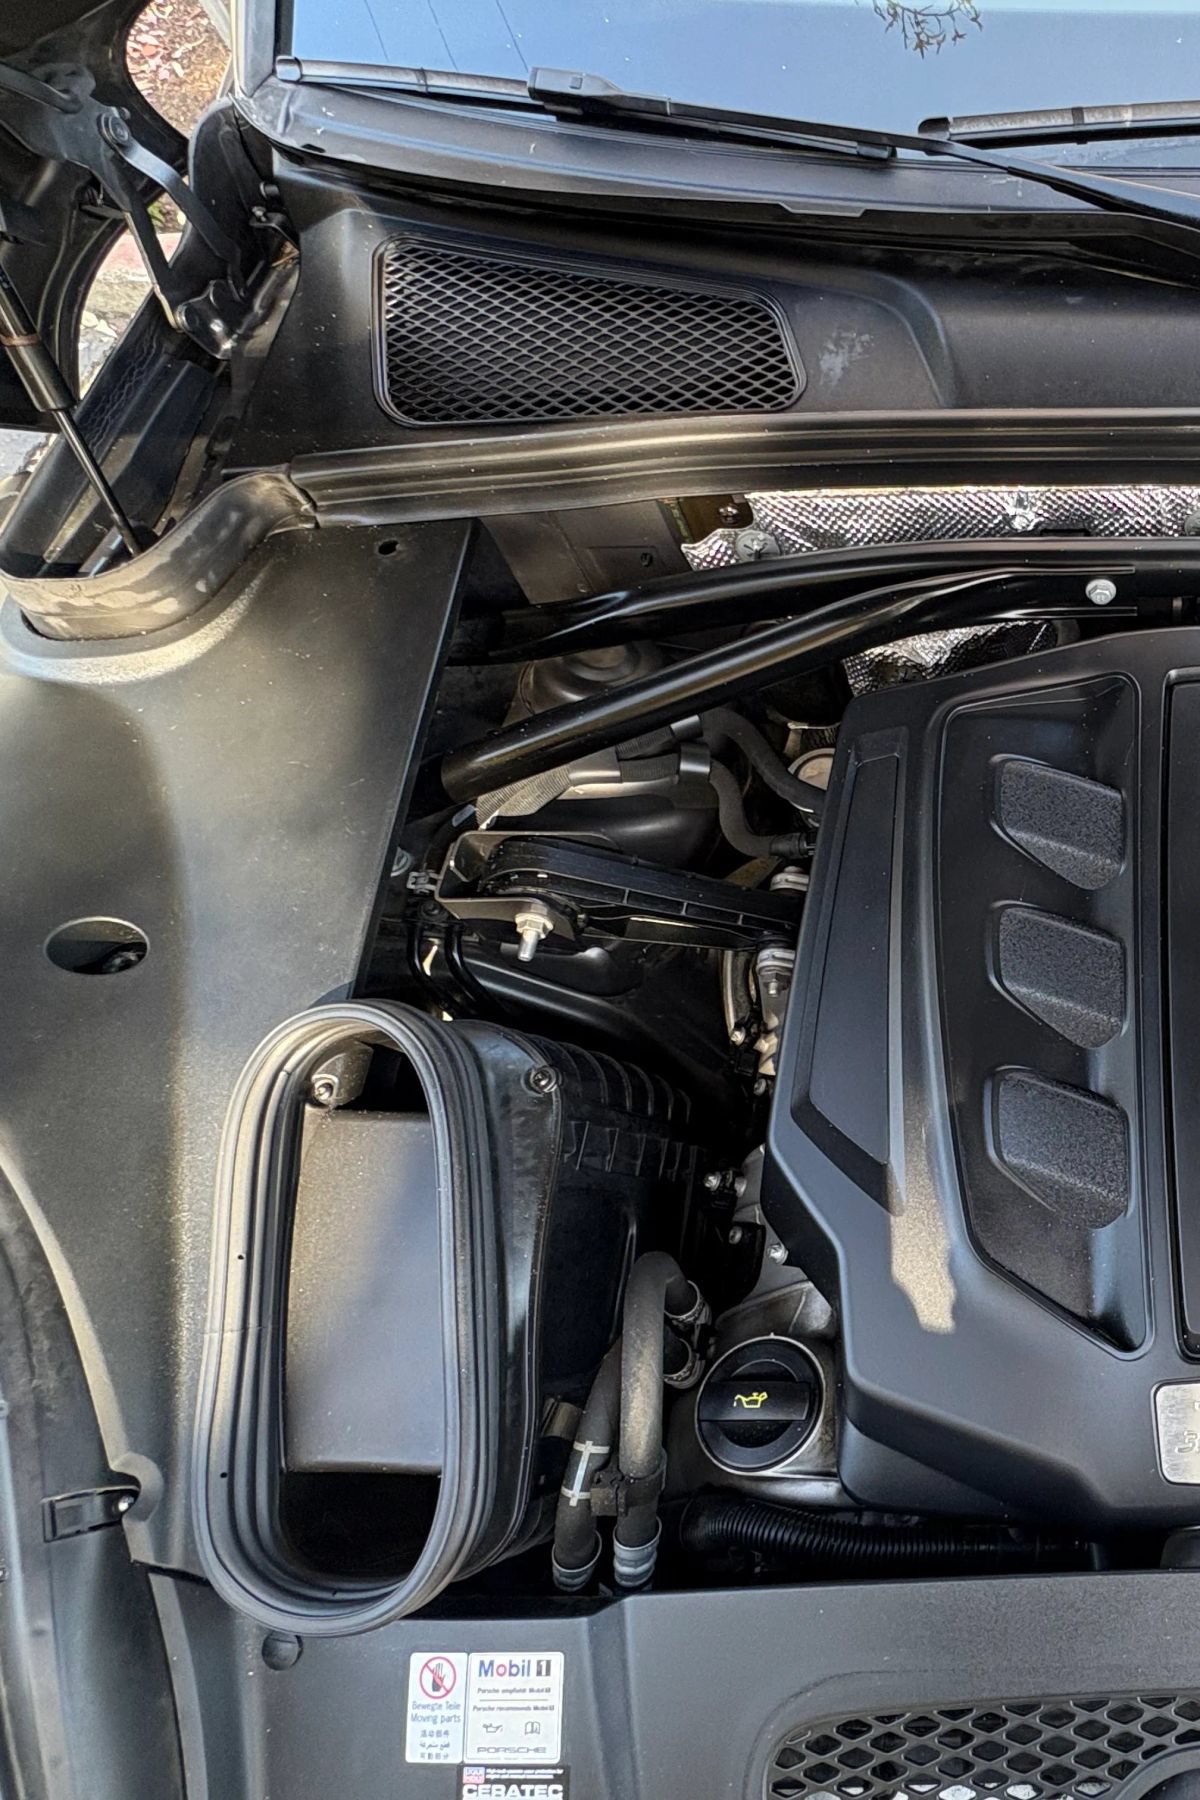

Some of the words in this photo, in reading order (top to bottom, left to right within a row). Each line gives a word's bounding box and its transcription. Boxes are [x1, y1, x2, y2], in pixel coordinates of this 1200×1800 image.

[478, 1659, 531, 1677] Mobil
[536, 1659, 551, 1677] 1
[440, 1714, 462, 1724] parts
[477, 1746, 547, 1754] PORSCHE
[462, 1784, 564, 1799] CERATEC
